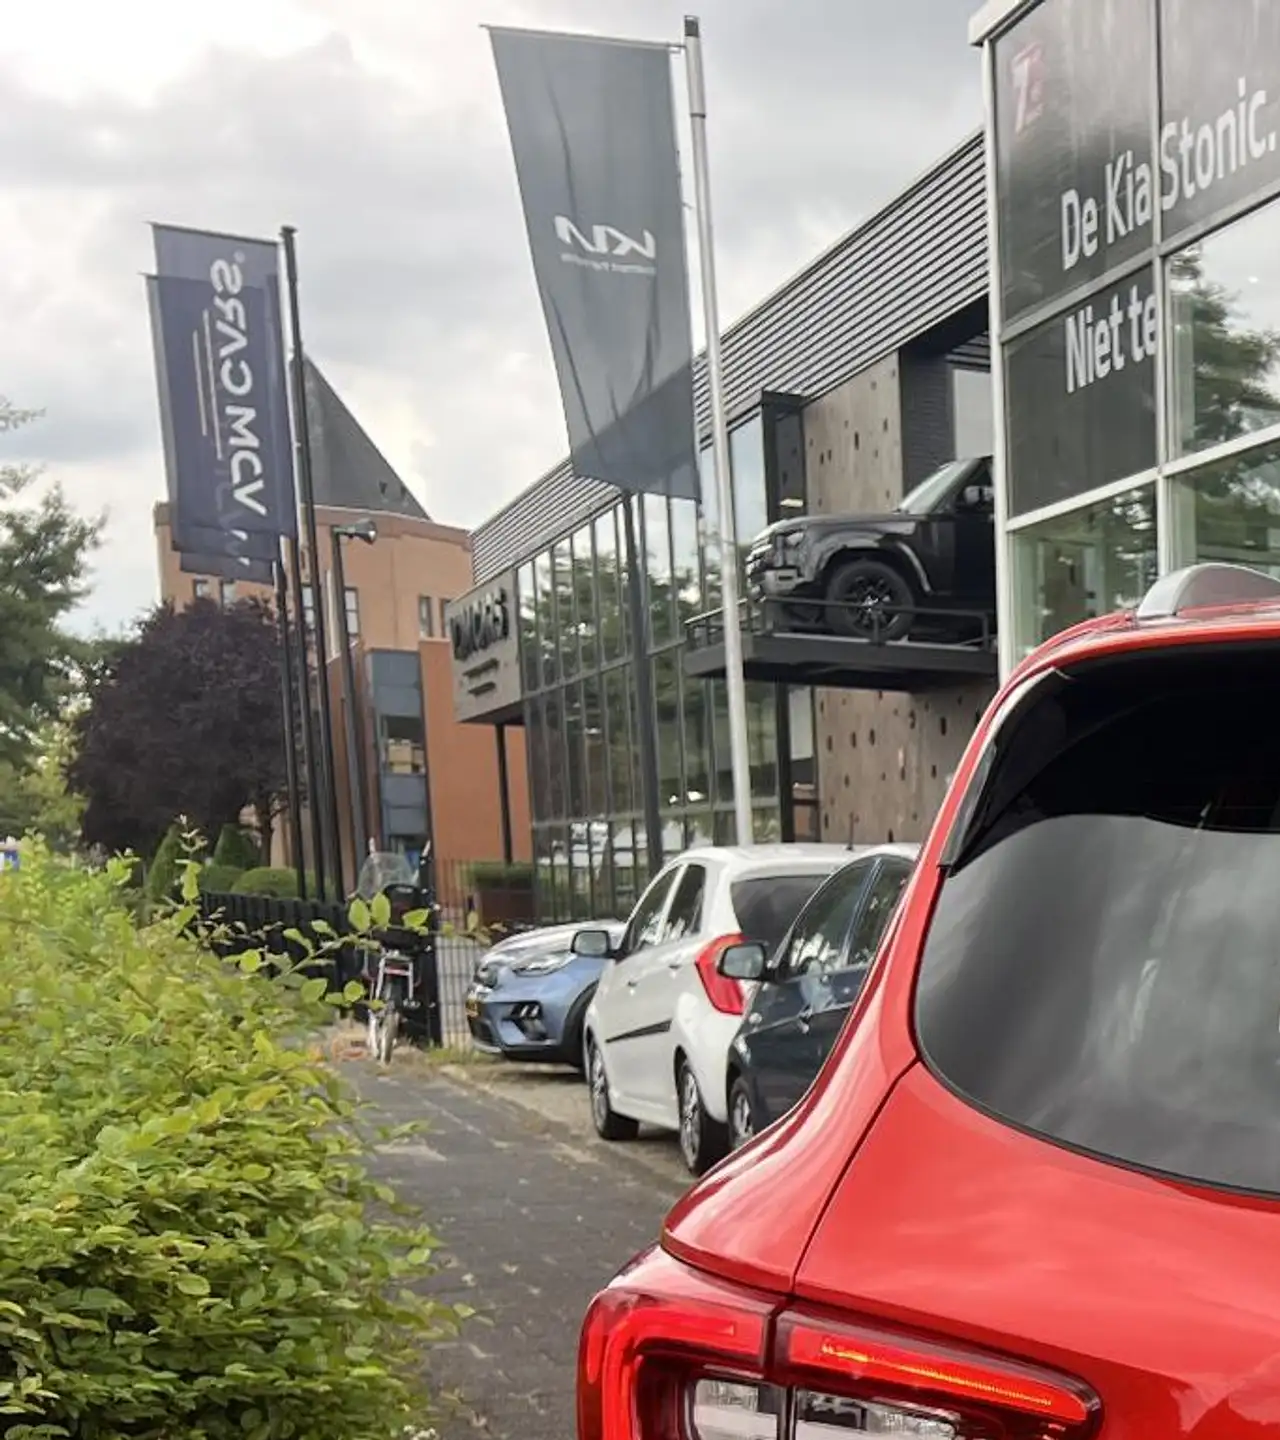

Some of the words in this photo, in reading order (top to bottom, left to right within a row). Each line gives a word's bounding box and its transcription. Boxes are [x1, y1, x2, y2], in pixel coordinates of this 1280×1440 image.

[1061, 189, 1099, 271] De
[1105, 150, 1151, 244] Kia
[1160, 76, 1277, 212] Stonic.
[1065, 293, 1126, 394] Niet
[1127, 283, 1157, 363] te
